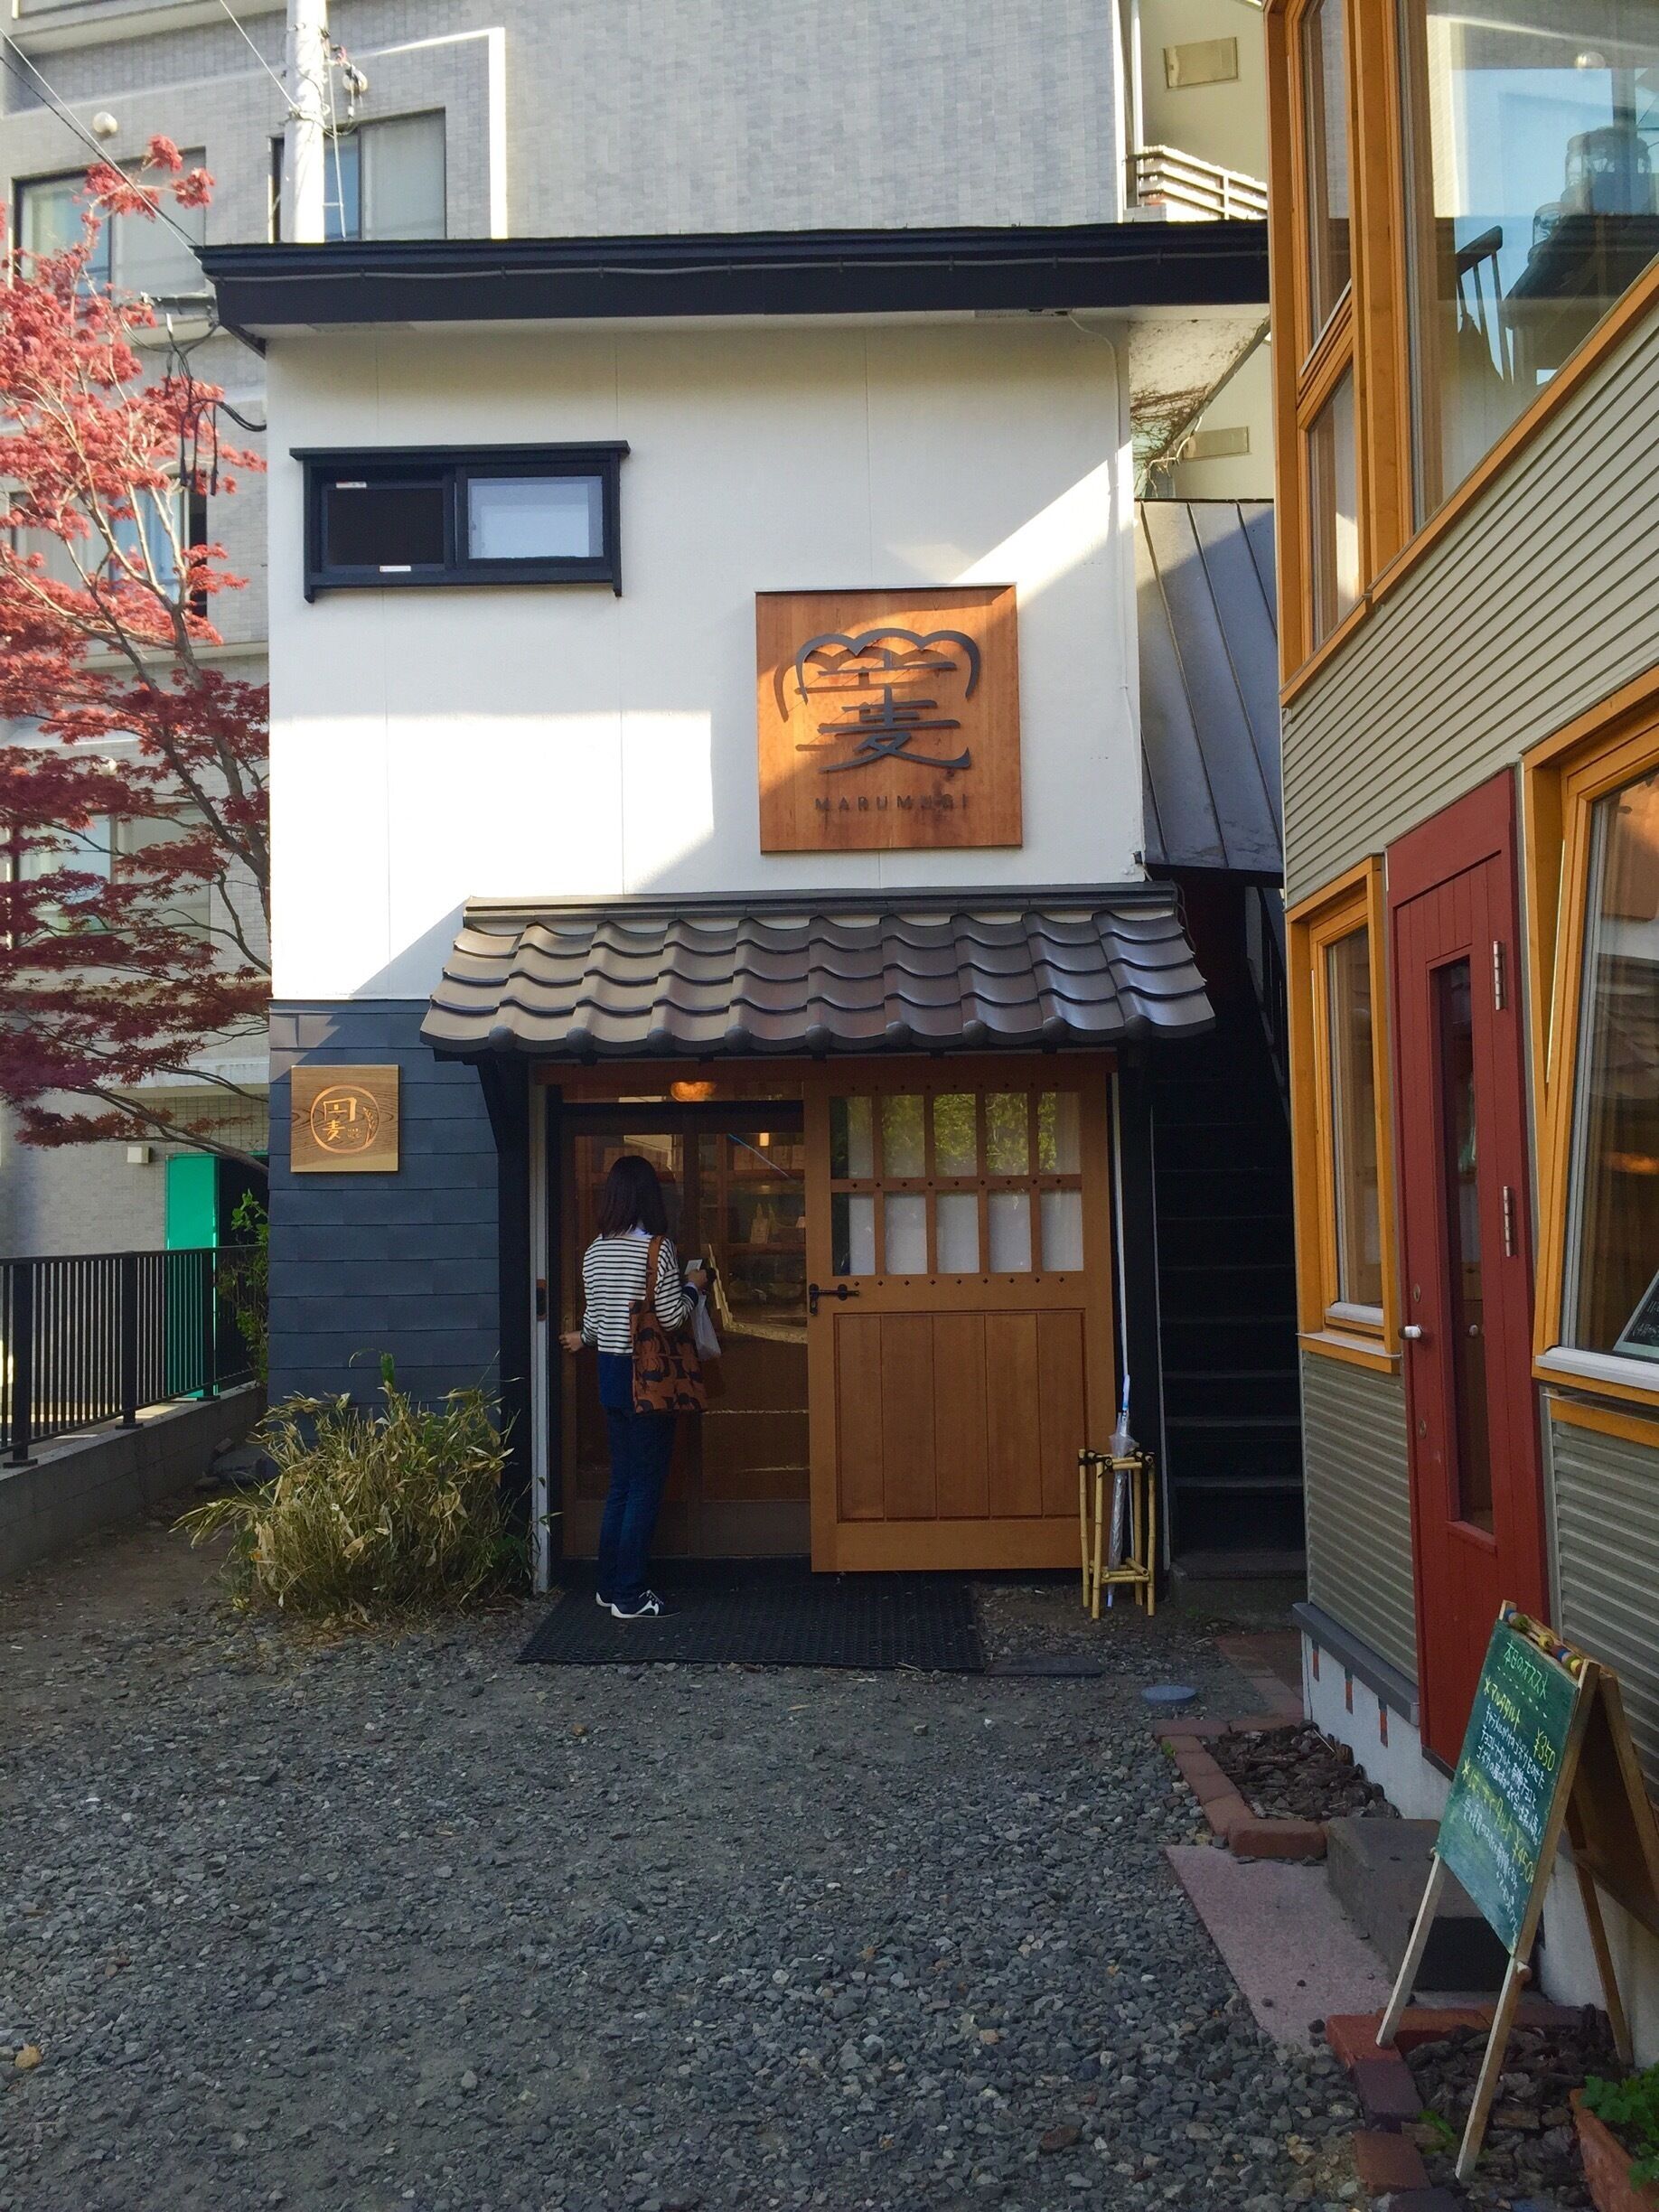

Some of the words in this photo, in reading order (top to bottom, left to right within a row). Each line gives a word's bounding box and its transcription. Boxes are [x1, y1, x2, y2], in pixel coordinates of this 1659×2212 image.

[814, 792, 970, 811] MARUMUGI
[1504, 1640, 1548, 1700] 本日のオススメ
